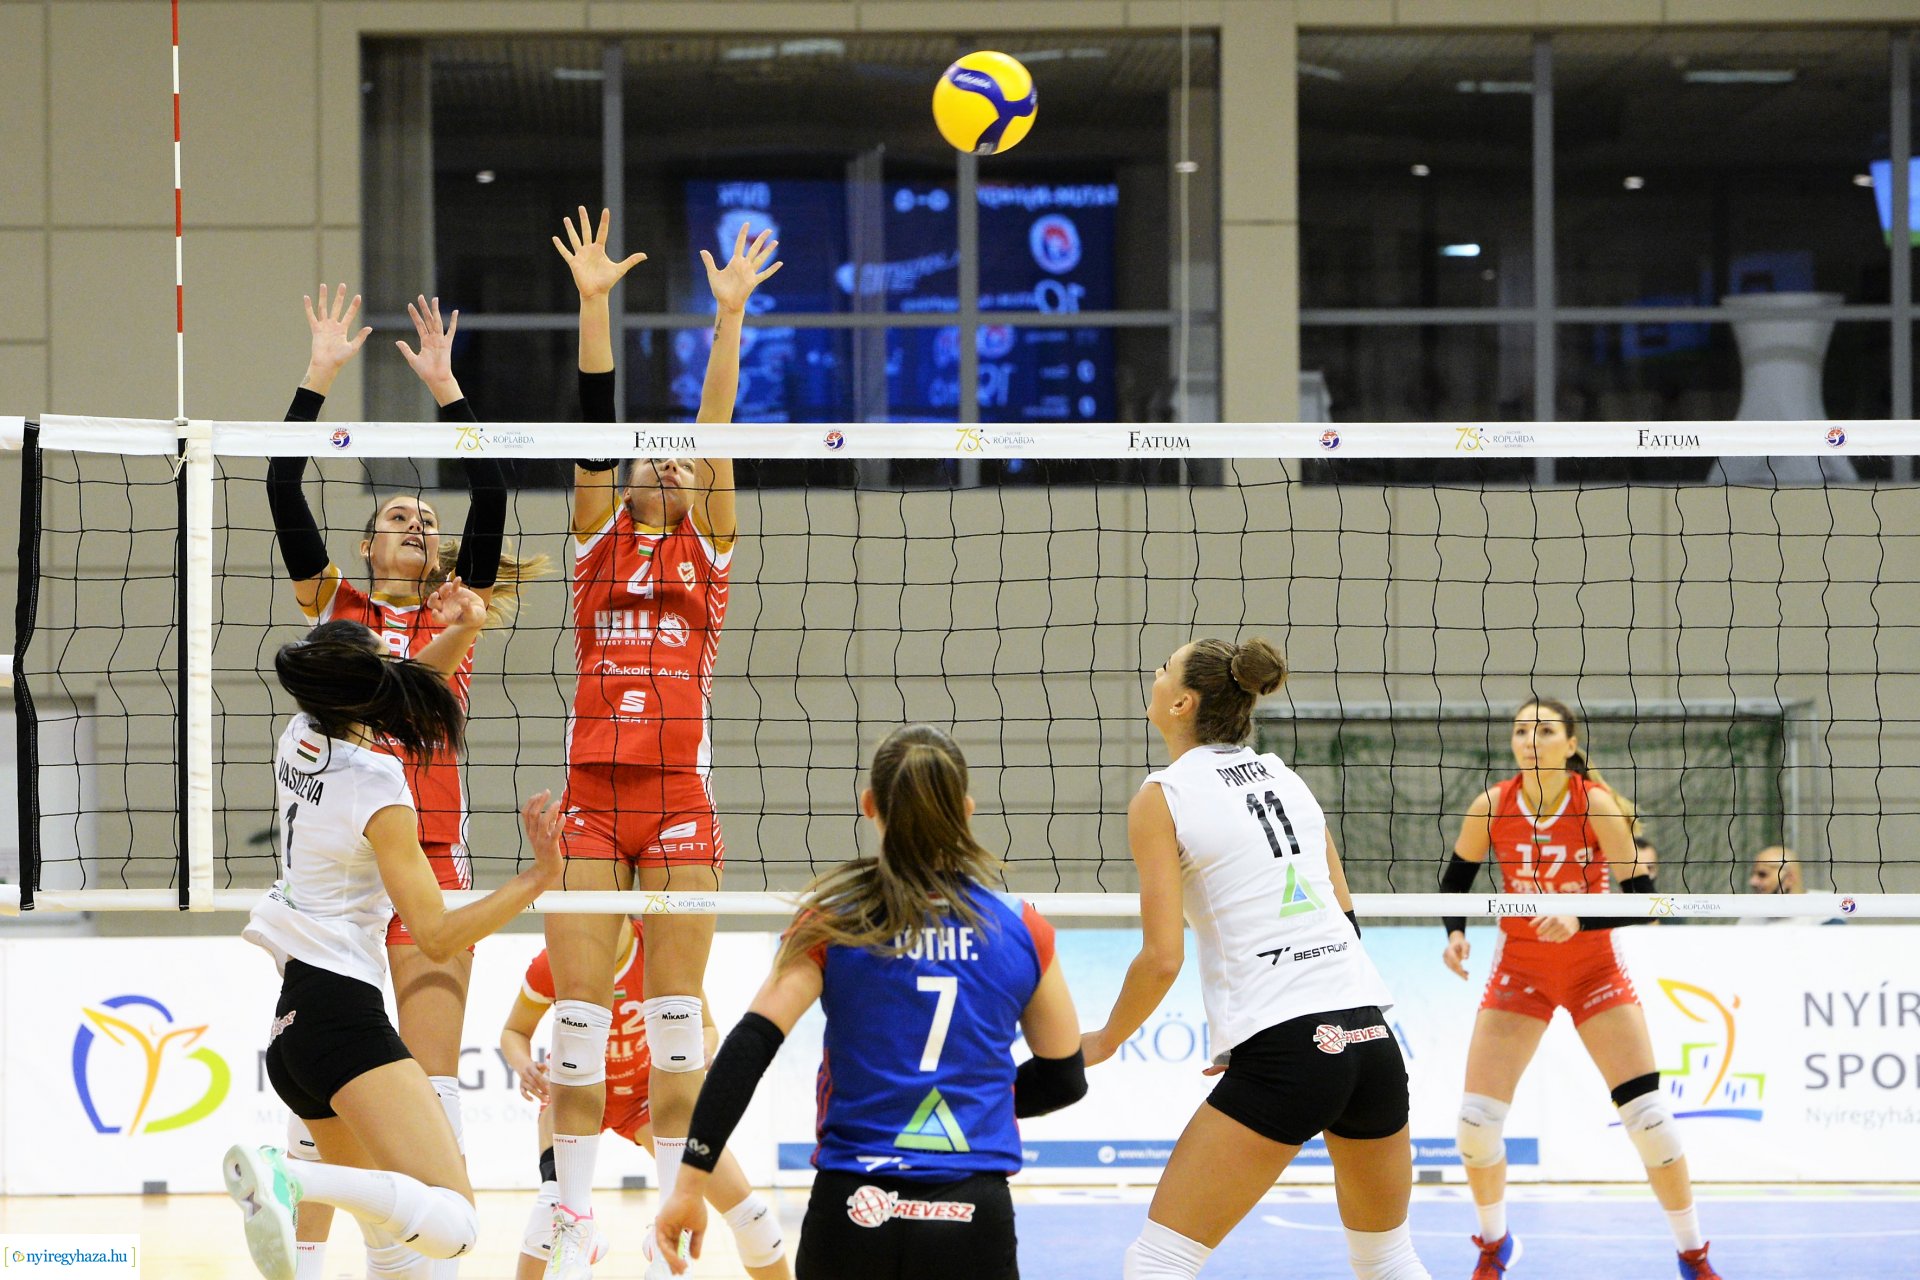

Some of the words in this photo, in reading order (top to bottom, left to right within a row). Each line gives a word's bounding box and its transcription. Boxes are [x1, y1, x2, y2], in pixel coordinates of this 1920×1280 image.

[633, 430, 696, 448] FATUM
[1128, 430, 1191, 448] FATUM
[1637, 428, 1700, 446] FATUM
[626, 560, 654, 600] 4
[594, 610, 654, 640] HELL
[278, 756, 324, 807] VASILEVA
[1215, 761, 1276, 788] PINTER
[285, 801, 299, 869] 1
[1246, 790, 1301, 859] 11
[648, 842, 708, 854] SEAT
[1515, 843, 1567, 878] 17
[1487, 899, 1537, 914] FATUM
[917, 976, 958, 1072] 7
[1804, 1053, 1920, 1090] SPO
[893, 1202, 974, 1220] REVESZ
